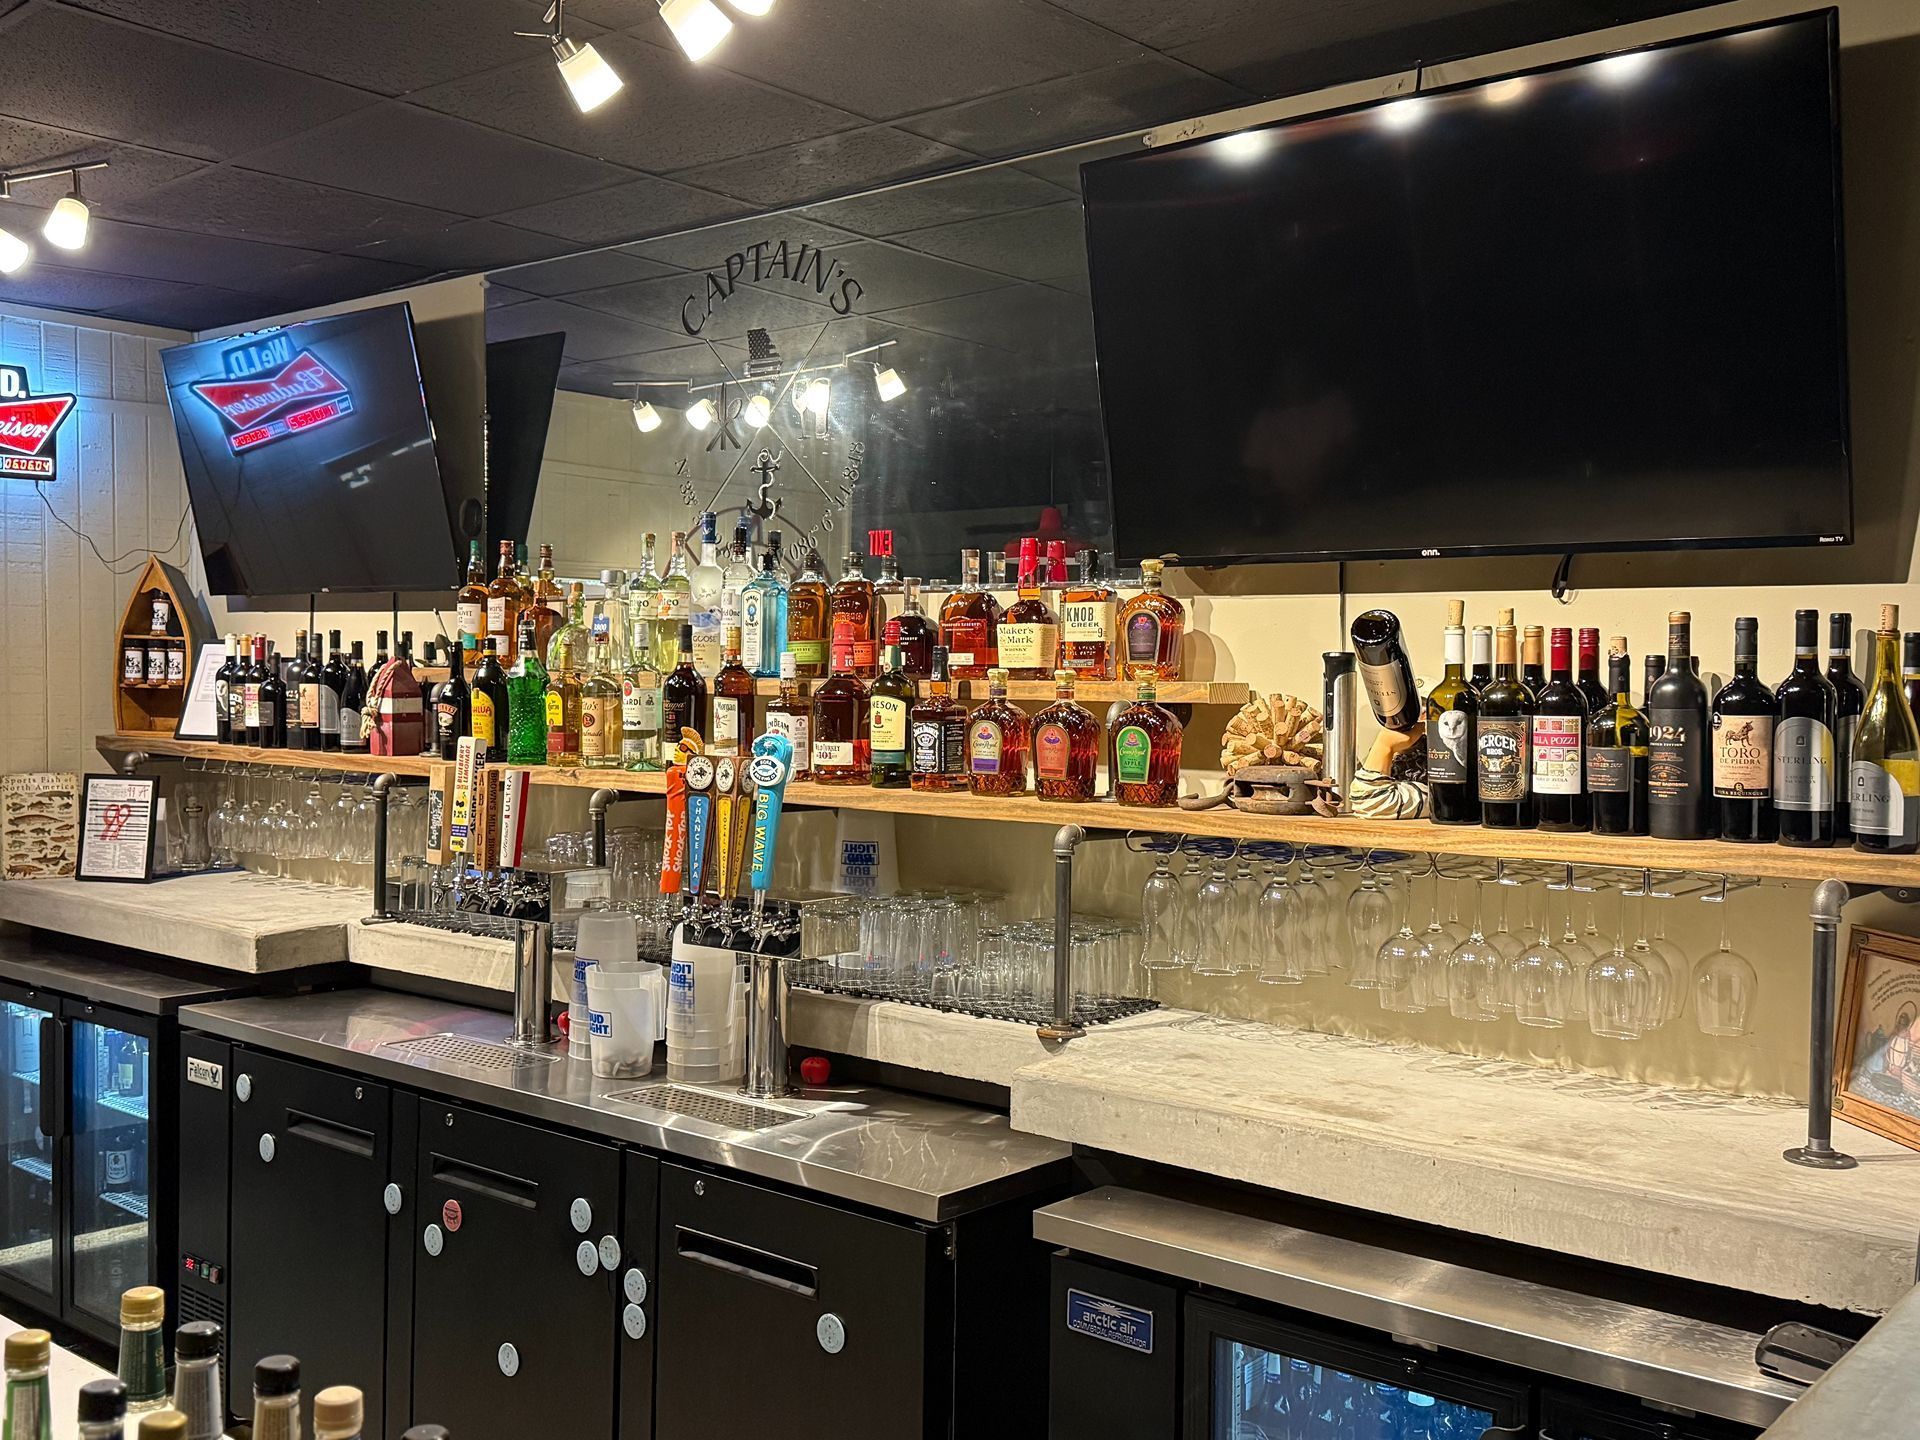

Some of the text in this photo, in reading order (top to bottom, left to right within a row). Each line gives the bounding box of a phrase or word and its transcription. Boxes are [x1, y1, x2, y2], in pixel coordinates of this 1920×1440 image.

[682, 240, 863, 335] CAPTAIN'S
[1066, 607, 1094, 622] KNOB
[999, 626, 1034, 635] Maker's
[1097, 628, 1103, 638] 9
[693, 635, 717, 643] GOOSE
[1007, 636, 1033, 644] Mark
[717, 702, 737, 712] Morgan
[1550, 736, 1576, 745] POZZI
[818, 751, 832, 760] 101
[1719, 747, 1761, 758] TORO
[1776, 755, 1827, 765] STERLING
[5, 777, 37, 785] Sports
[41, 776, 60, 784] Fish
[3, 784, 31, 792] North
[694, 798, 702, 849] CHANCE
[752, 793, 769, 871] BIG WAVE
[189, 1062, 210, 1079] Falcon
[1082, 1311, 1137, 1335] arctic air
[1073, 1319, 1147, 1348] COMMERCIAL REFRIGERATOR
